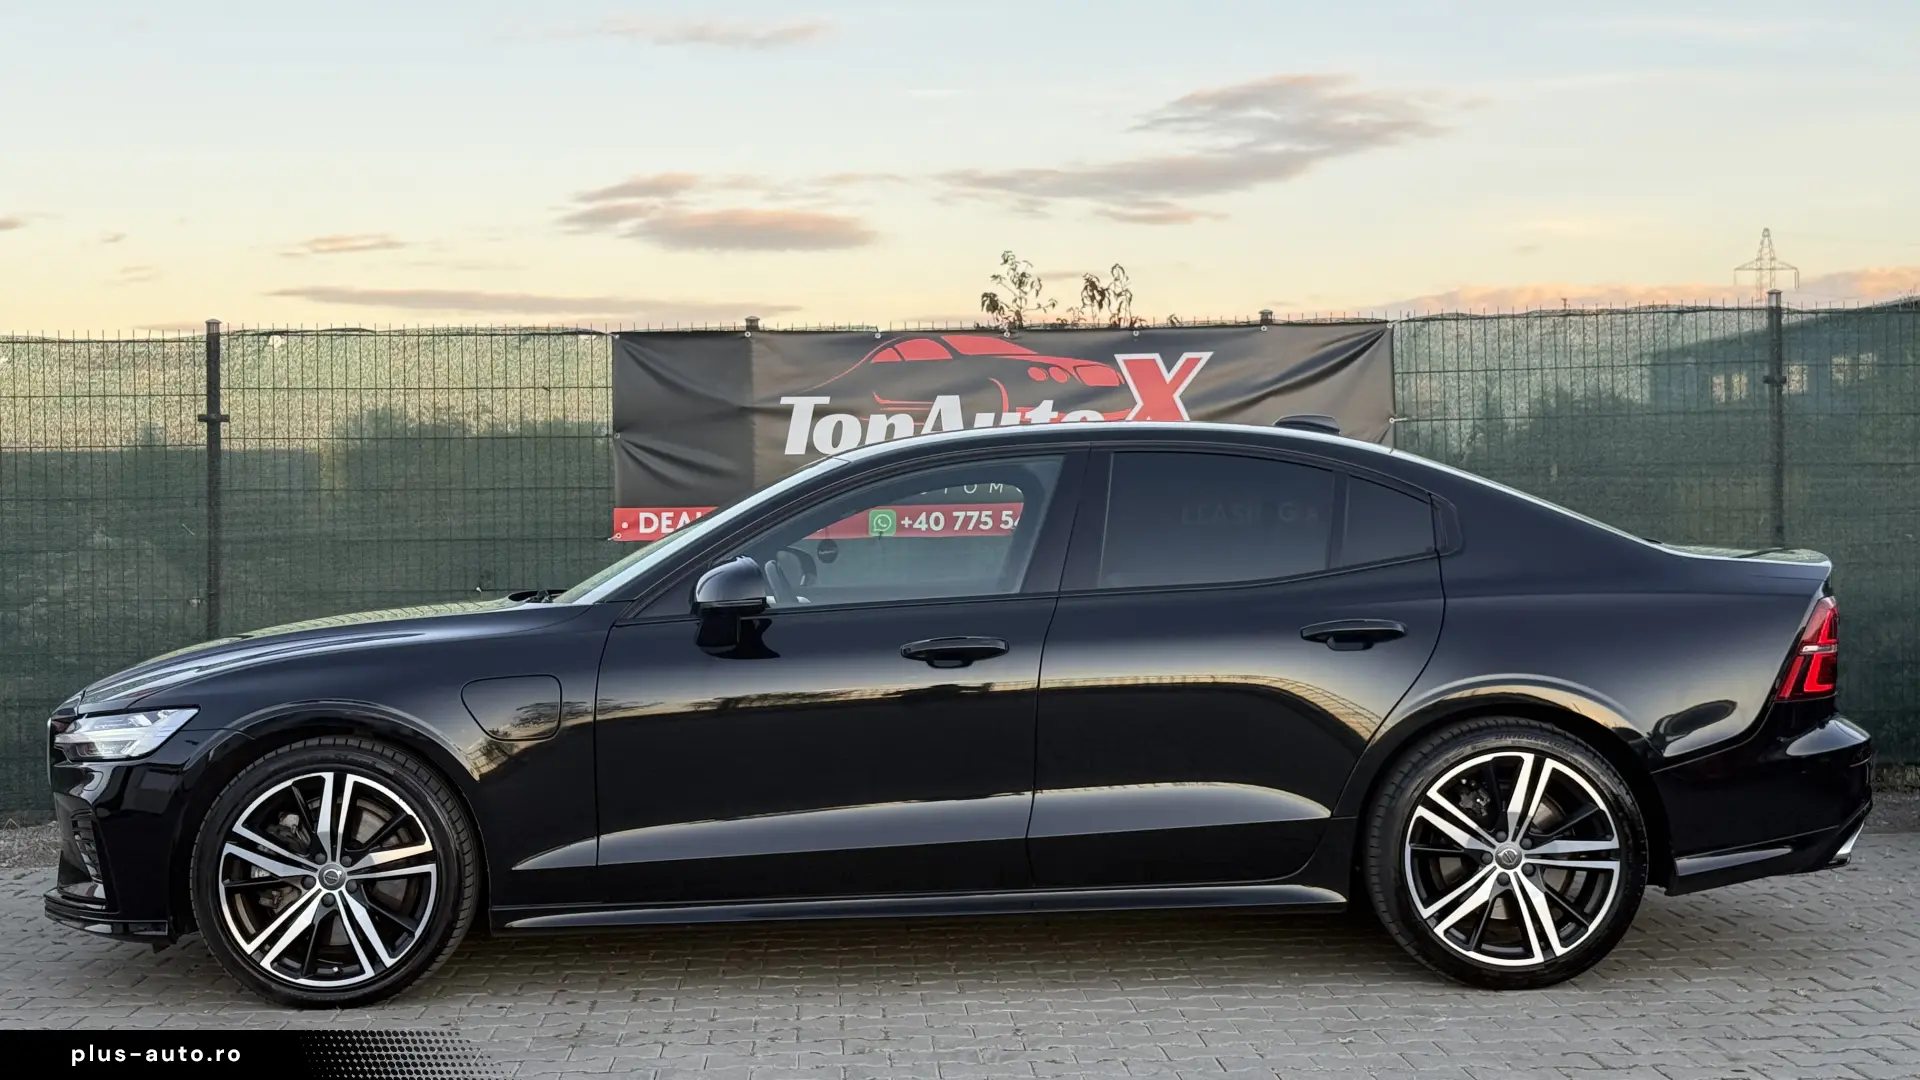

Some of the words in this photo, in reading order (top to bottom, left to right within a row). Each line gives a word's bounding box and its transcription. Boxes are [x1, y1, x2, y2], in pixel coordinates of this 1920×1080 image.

[780, 351, 1214, 455] ToAX
[639, 511, 703, 534] DEA
[900, 511, 945, 531] +40
[952, 511, 993, 531] 775
